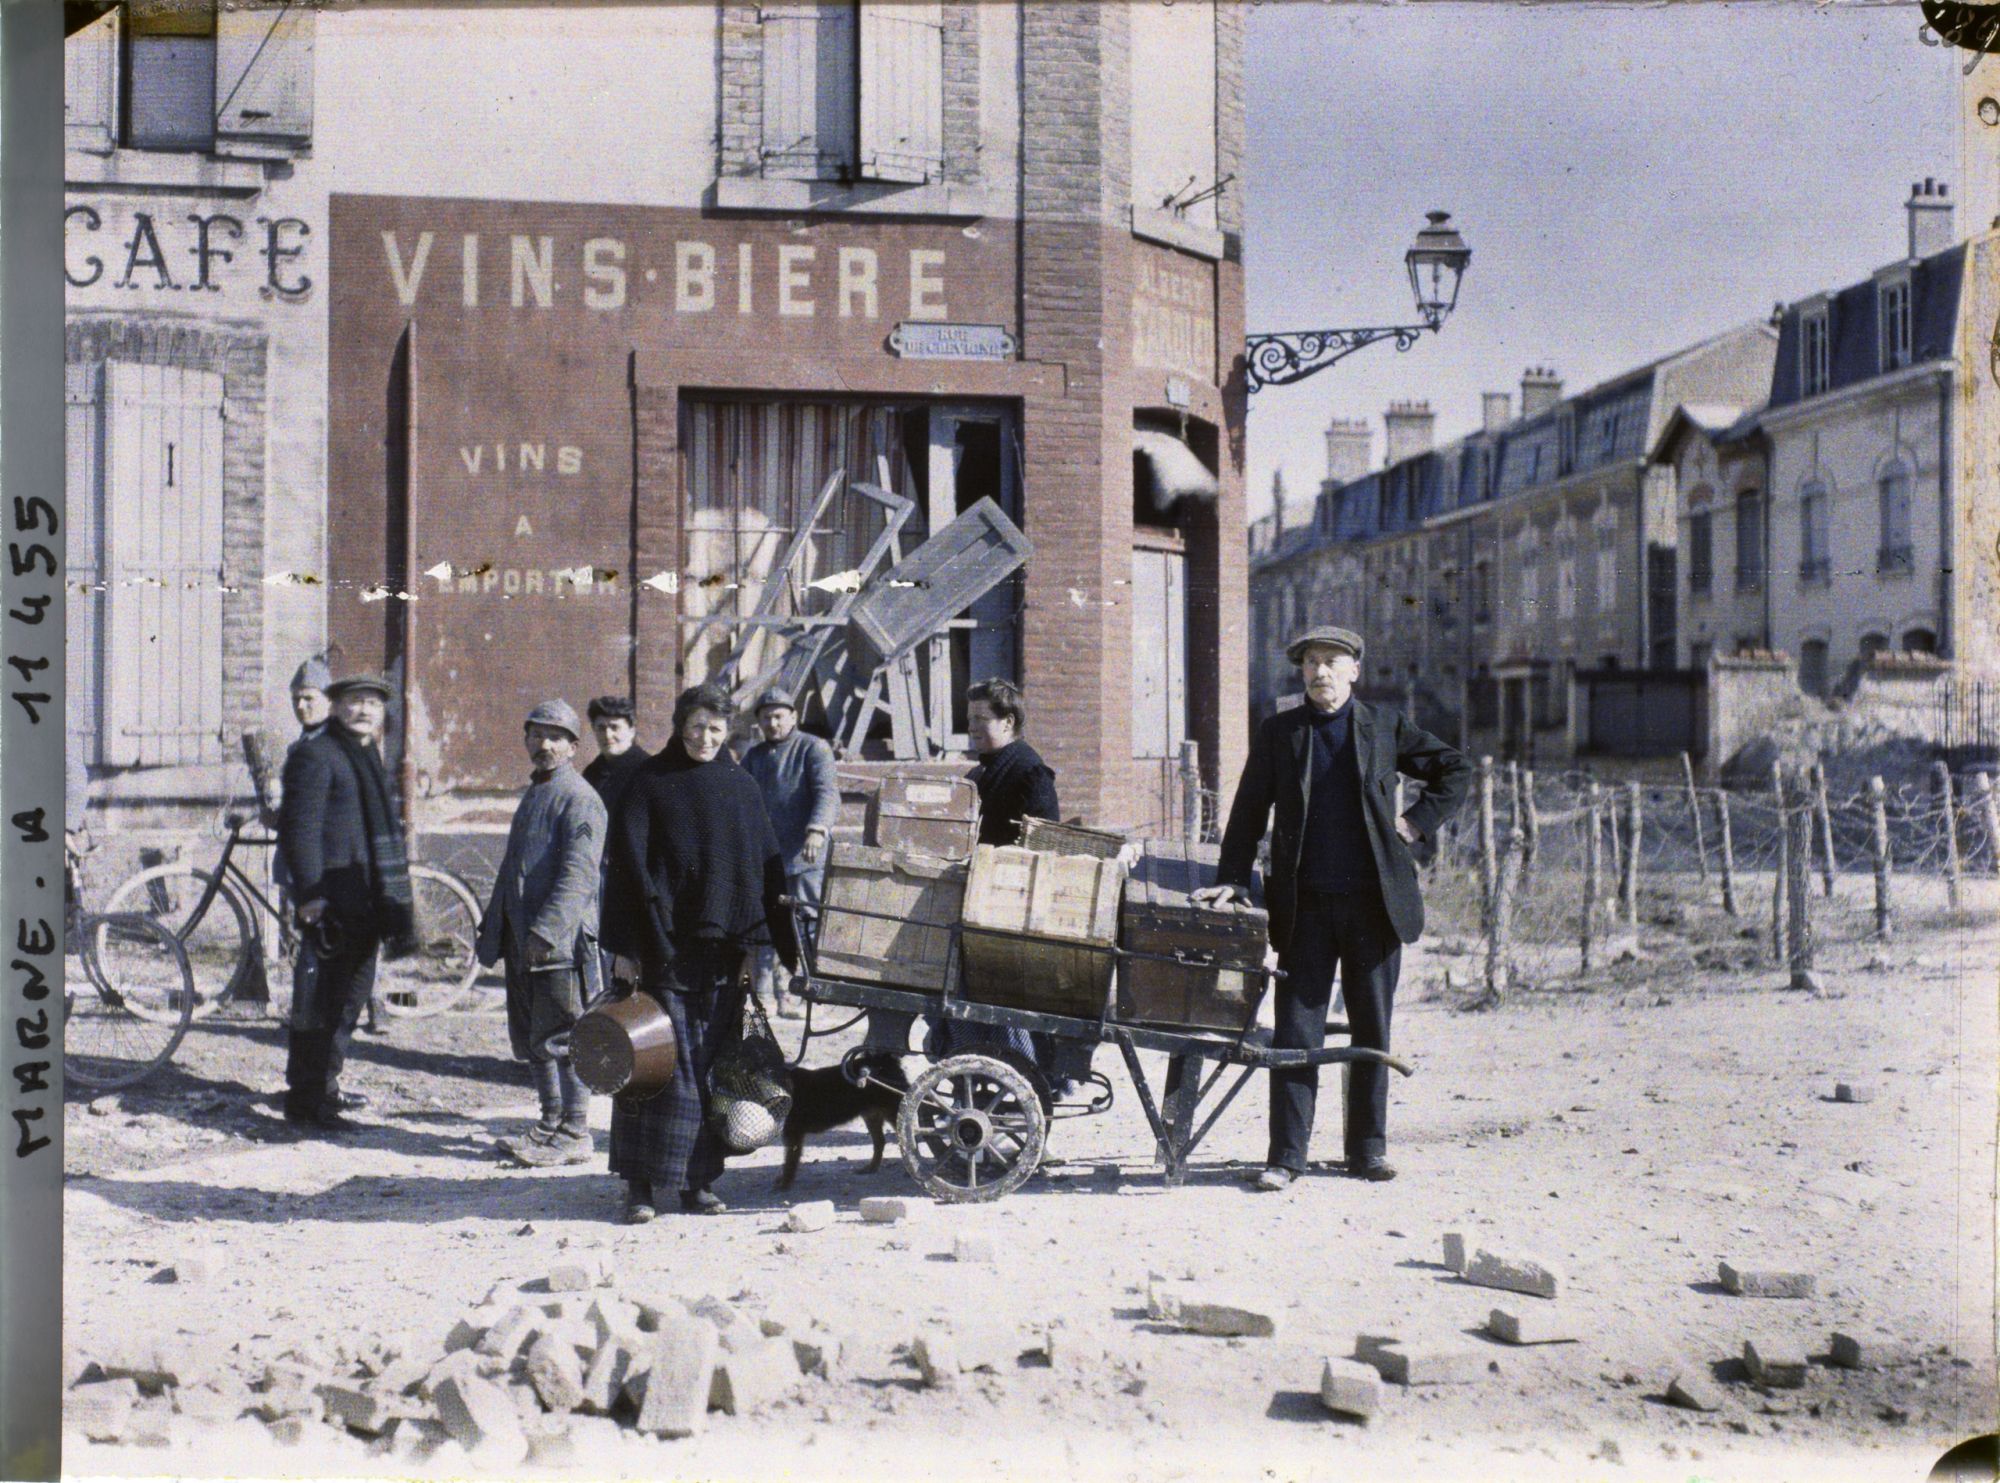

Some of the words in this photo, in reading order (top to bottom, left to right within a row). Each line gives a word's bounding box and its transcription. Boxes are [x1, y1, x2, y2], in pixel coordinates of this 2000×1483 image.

[382, 231, 624, 310] VINS
[675, 240, 948, 319] BIERE
[904, 341, 923, 354] DE
[938, 329, 968, 341] RUE
[460, 443, 583, 474] VINS
[515, 515, 533, 536] A
[11, 807, 49, 842] A
[12, 918, 55, 1158] MARNE
